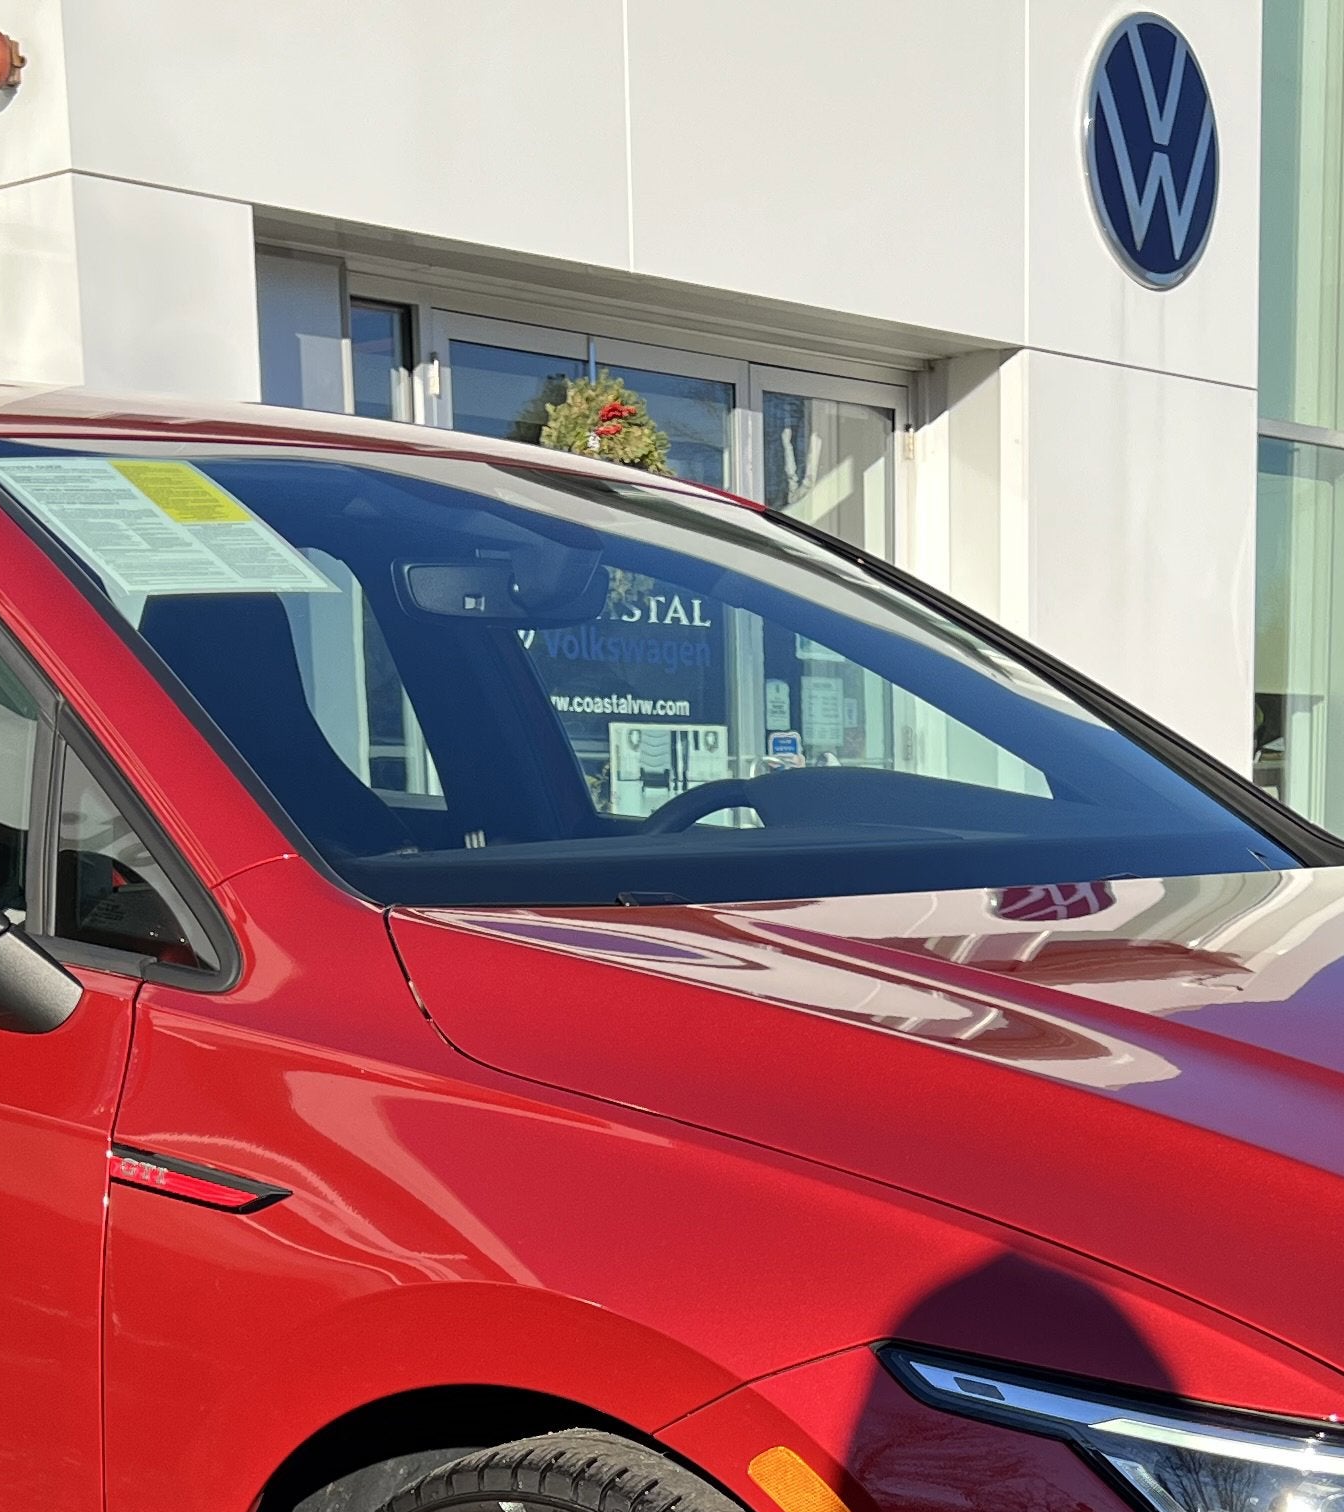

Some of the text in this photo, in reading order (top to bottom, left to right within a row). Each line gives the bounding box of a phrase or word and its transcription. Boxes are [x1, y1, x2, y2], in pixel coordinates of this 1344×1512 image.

[1086, 13, 1217, 285] VW
[595, 593, 712, 628] ASTAL
[543, 624, 712, 674] Volkswagen
[550, 693, 690, 717] w.coastalvw.com
